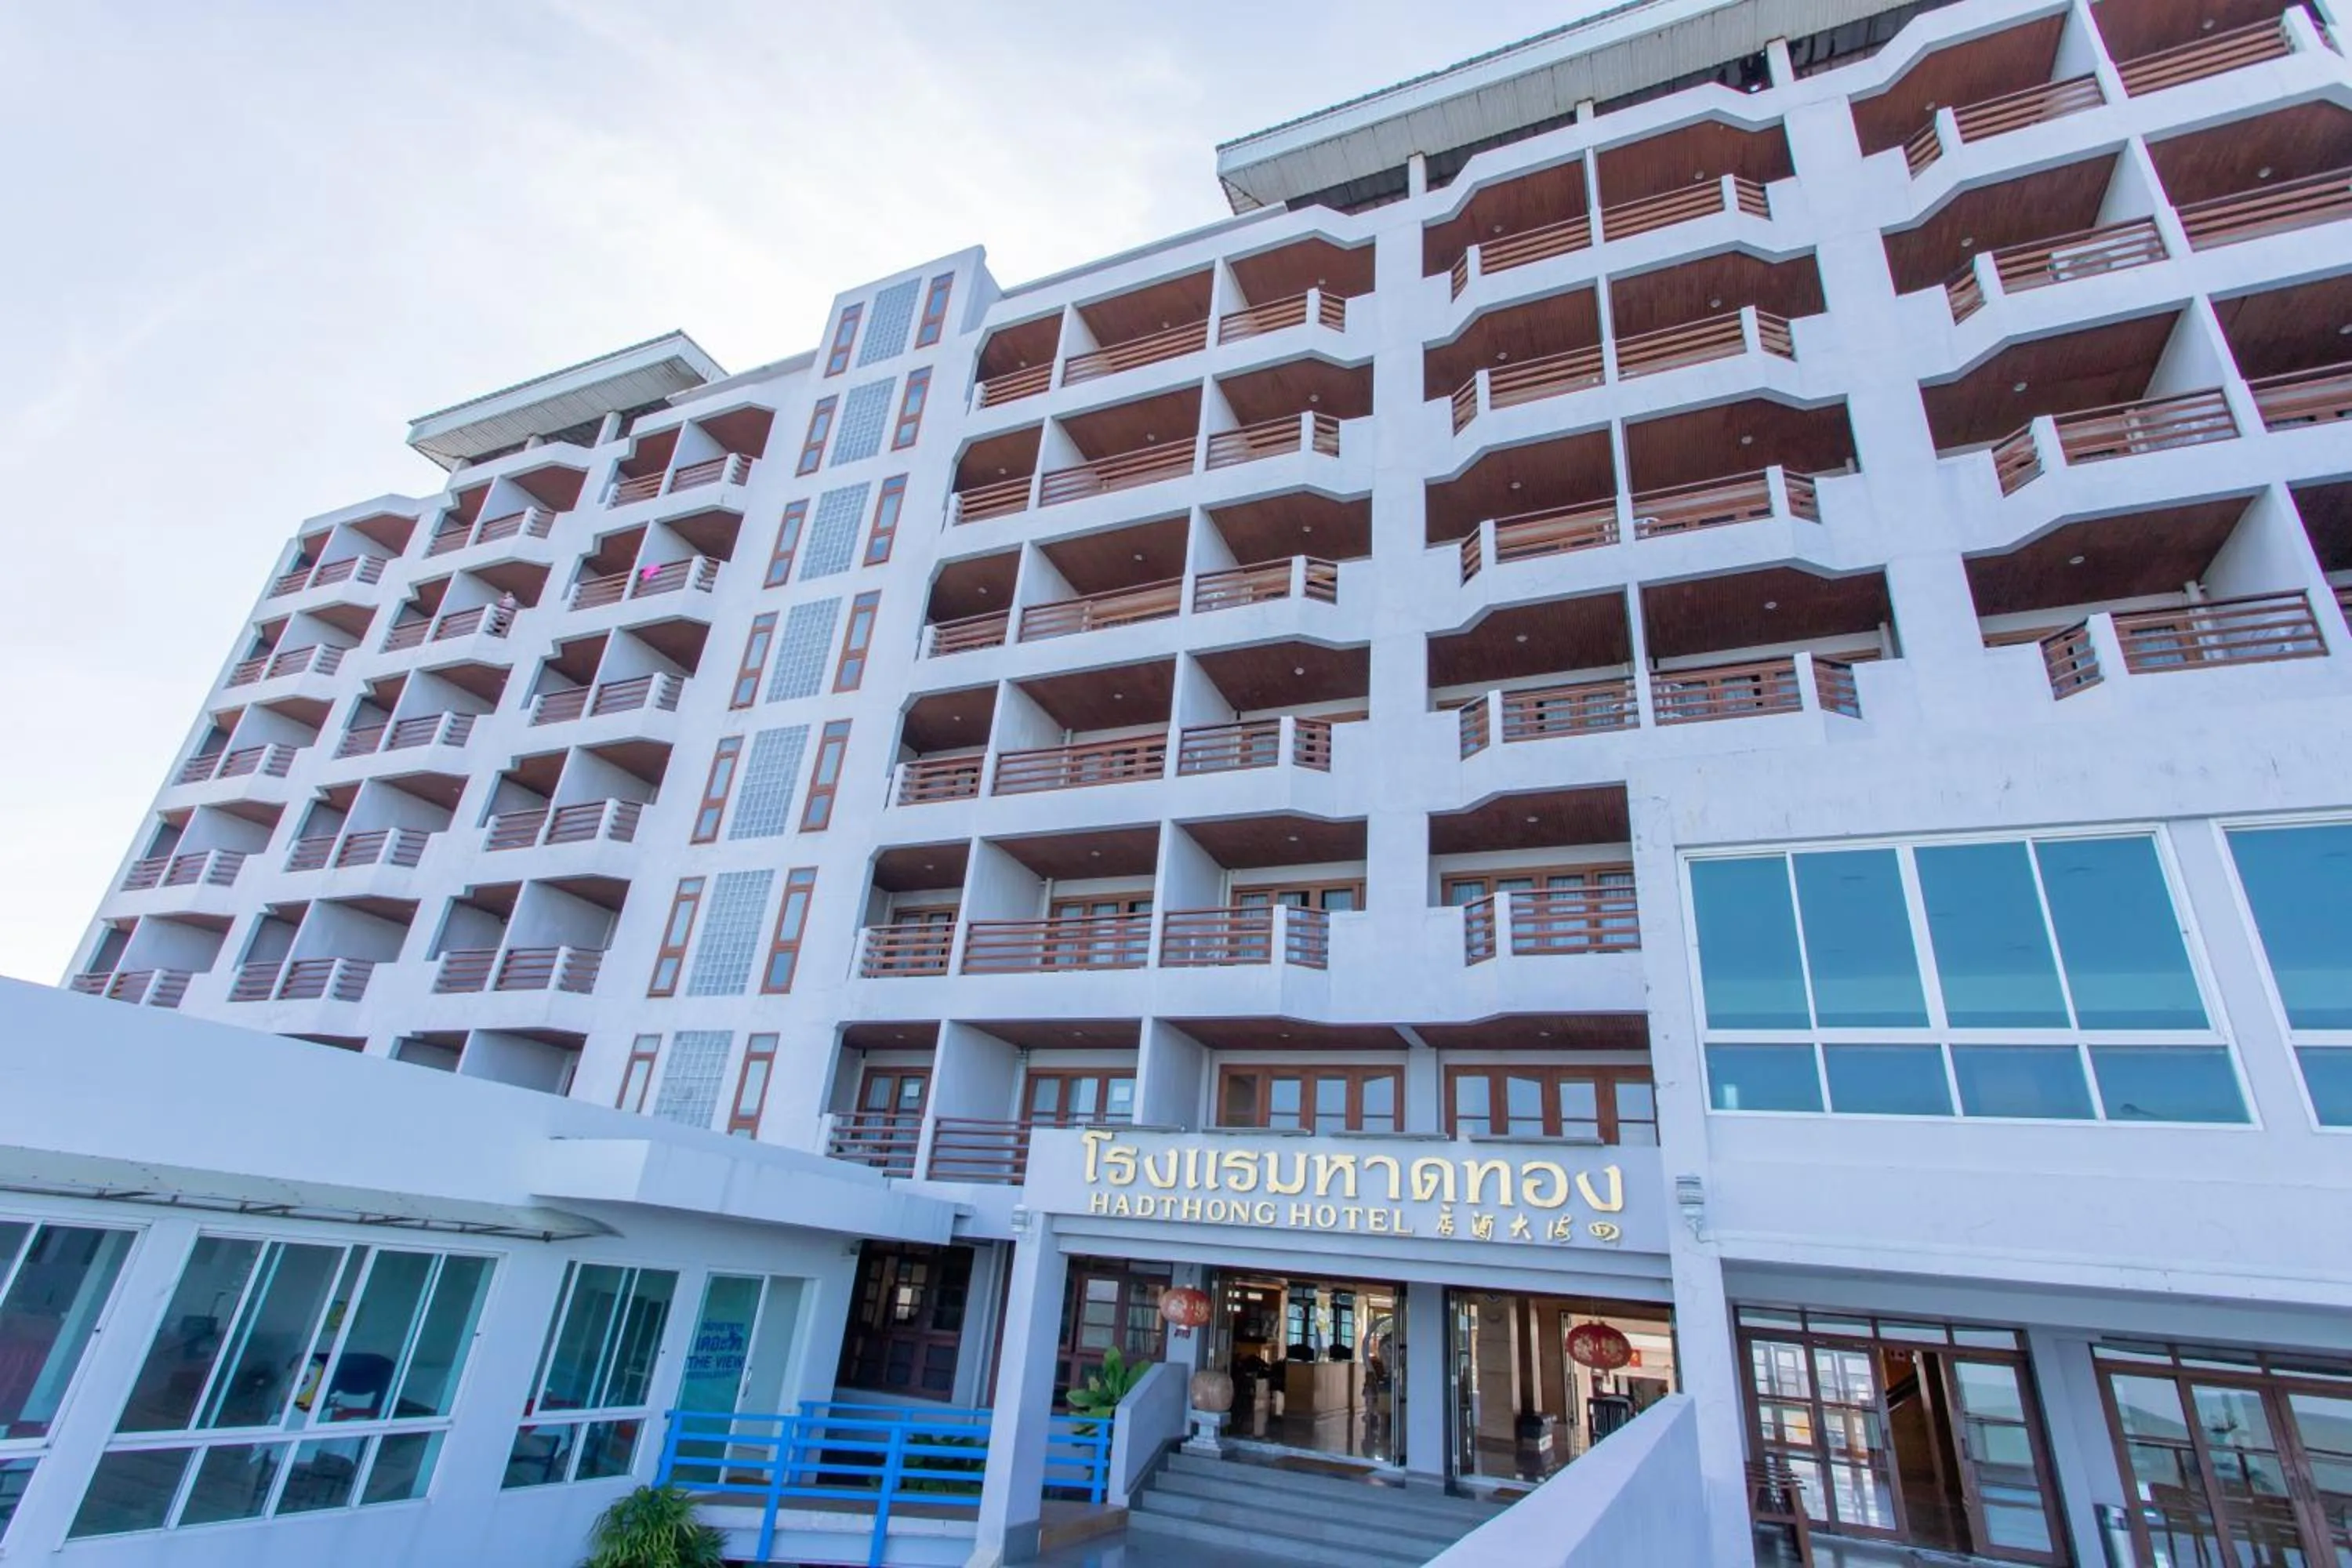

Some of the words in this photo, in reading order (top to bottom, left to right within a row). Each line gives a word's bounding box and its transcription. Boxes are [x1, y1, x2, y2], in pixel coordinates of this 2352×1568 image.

[1081, 1129, 1624, 1212] โรงแรมหาดทอง
[1089, 1190, 1277, 1225] HADTHONG
[1288, 1202, 1414, 1235] HOTEL
